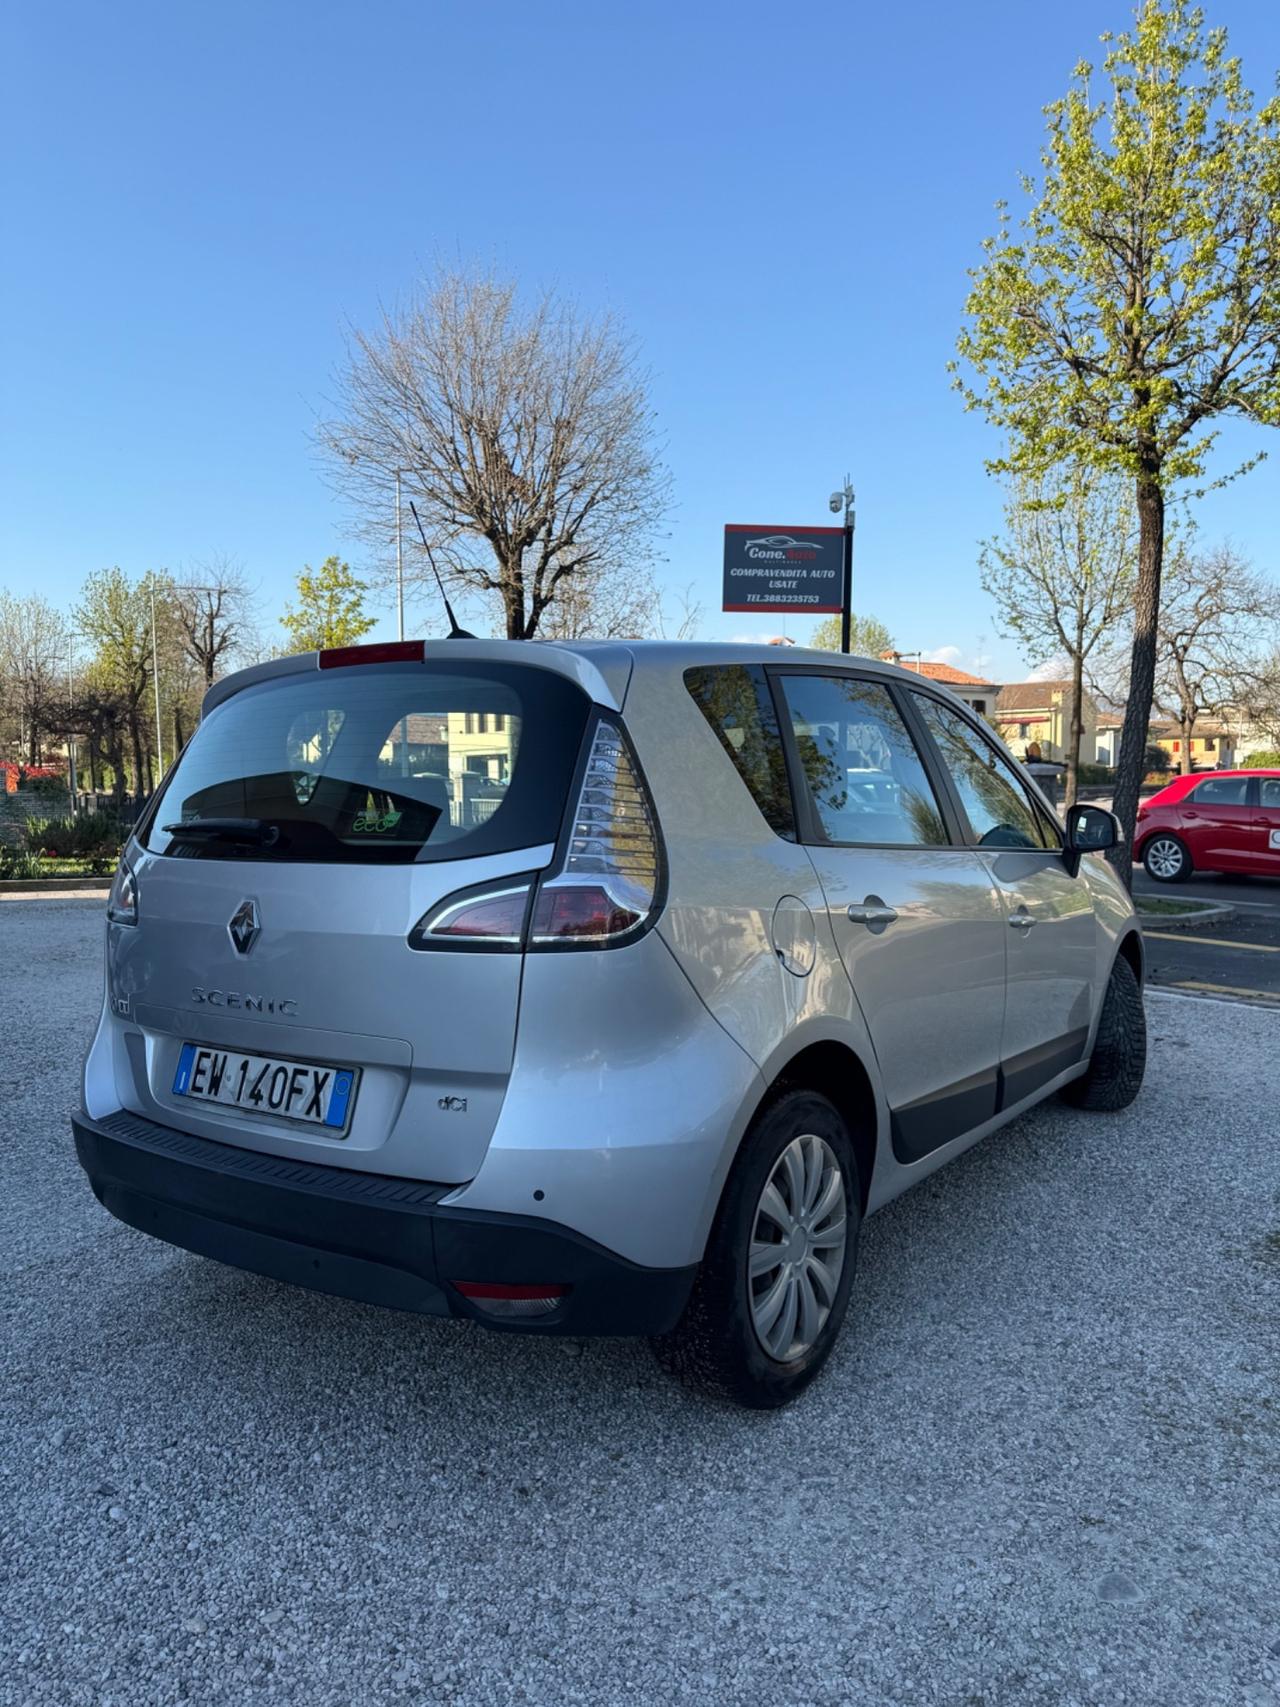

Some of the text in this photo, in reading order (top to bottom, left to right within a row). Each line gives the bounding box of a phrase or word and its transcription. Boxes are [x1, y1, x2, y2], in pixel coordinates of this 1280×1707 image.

[730, 568, 835, 579] COMPRAVENDITA AUTO
[768, 580, 798, 589] USATE
[191, 986, 299, 1017] SCENIC
